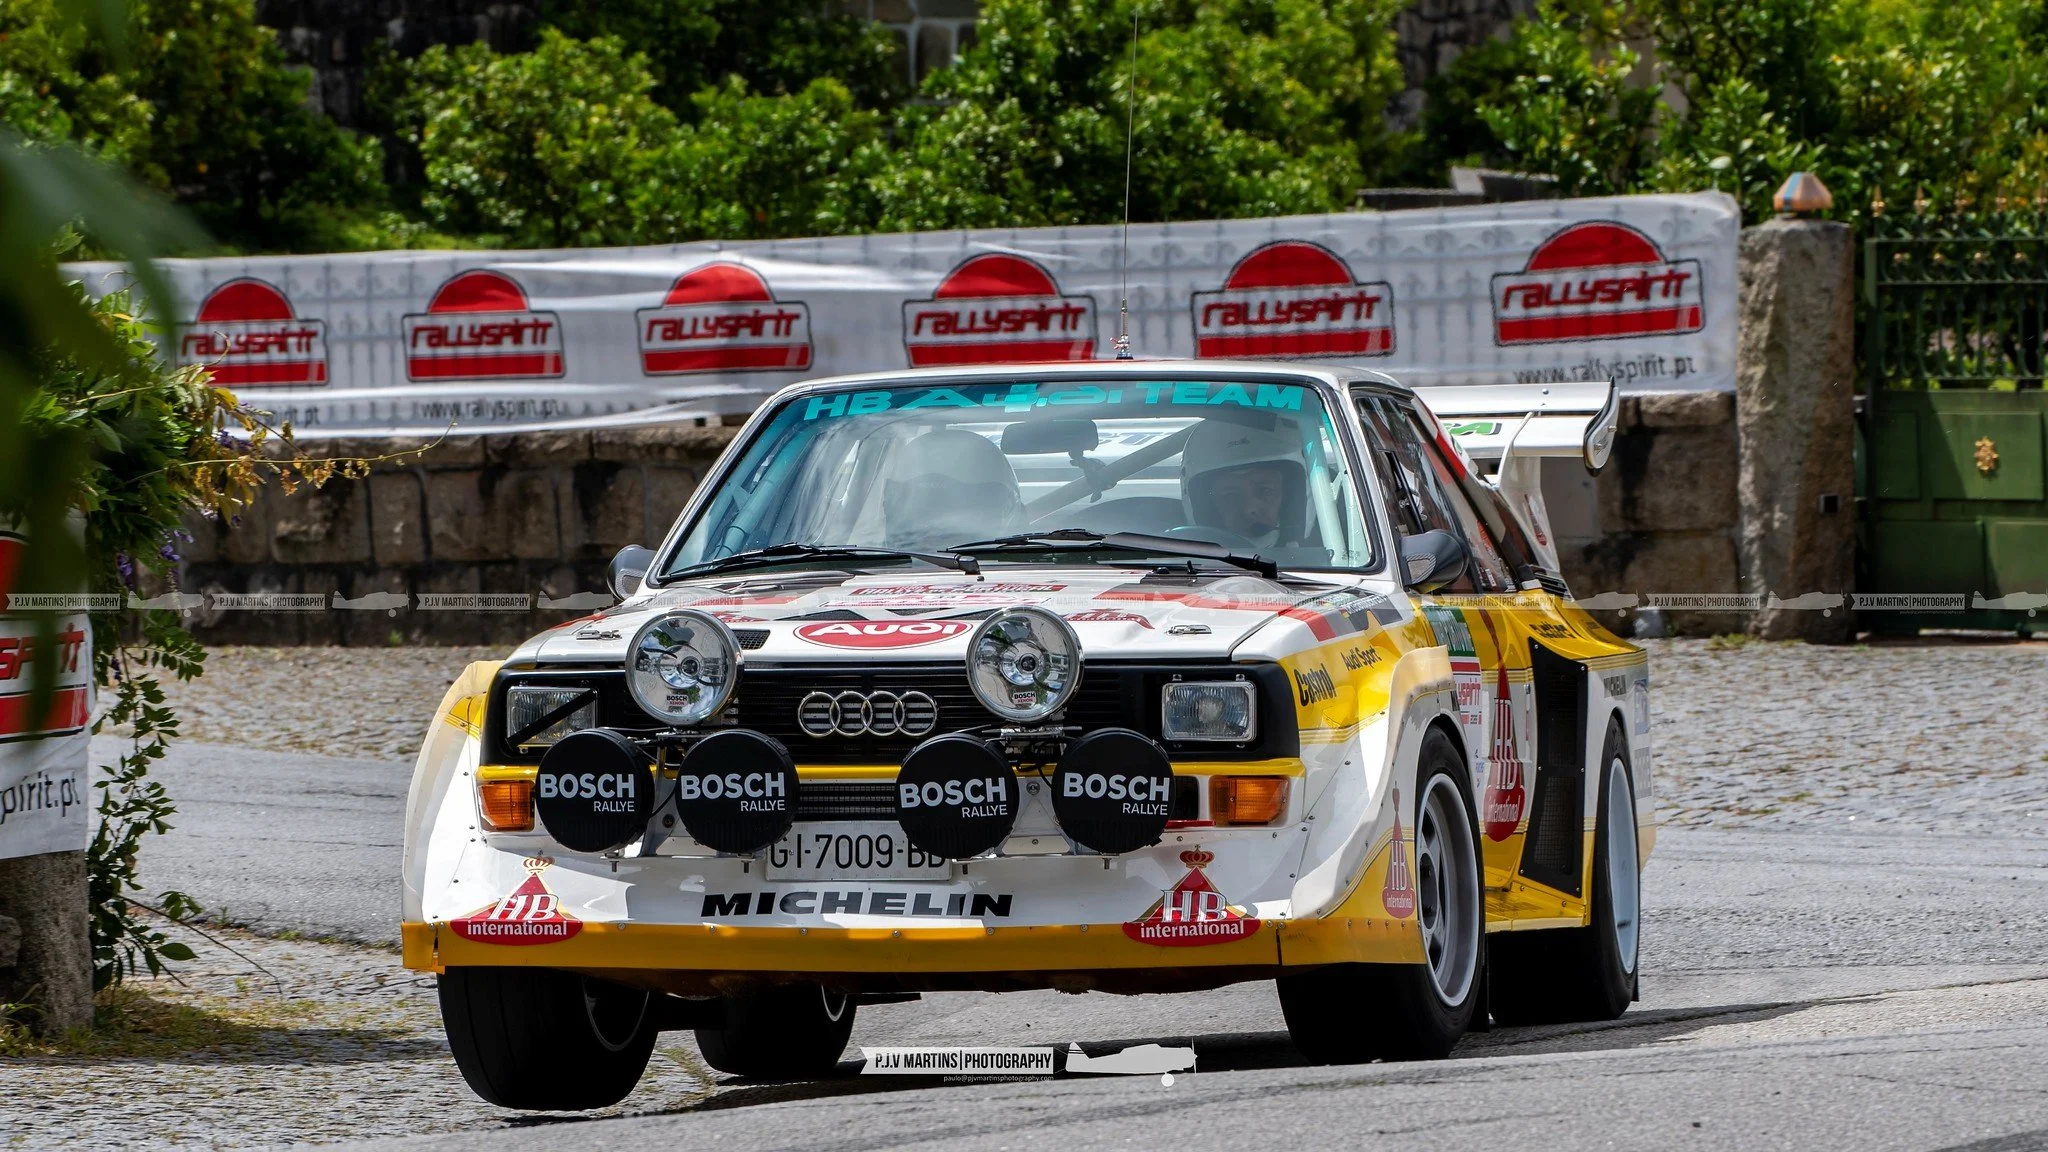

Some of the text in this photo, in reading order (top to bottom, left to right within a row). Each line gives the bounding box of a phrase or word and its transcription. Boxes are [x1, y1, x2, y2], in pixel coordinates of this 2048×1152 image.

[803, 391, 891, 420] HB
[1136, 381, 1303, 410] TEAM
[1340, 645, 1383, 672] Audi Sport
[1294, 662, 1337, 707] Castrol
[539, 773, 635, 799] BOSCH
[680, 772, 786, 800] BOSCH
[900, 777, 1007, 809] BOSCH
[1063, 772, 1170, 802] BOSCH
[593, 801, 635, 812] RALLYE
[740, 800, 786, 812] RALLYE
[961, 804, 1008, 818] RALLYE
[1122, 802, 1168, 816] RALLYE
[487, 894, 559, 921] HB
[701, 890, 1014, 918] MICHELIN
[1161, 889, 1229, 922] HB
[467, 919, 567, 936] international
[1140, 919, 1245, 939] international
